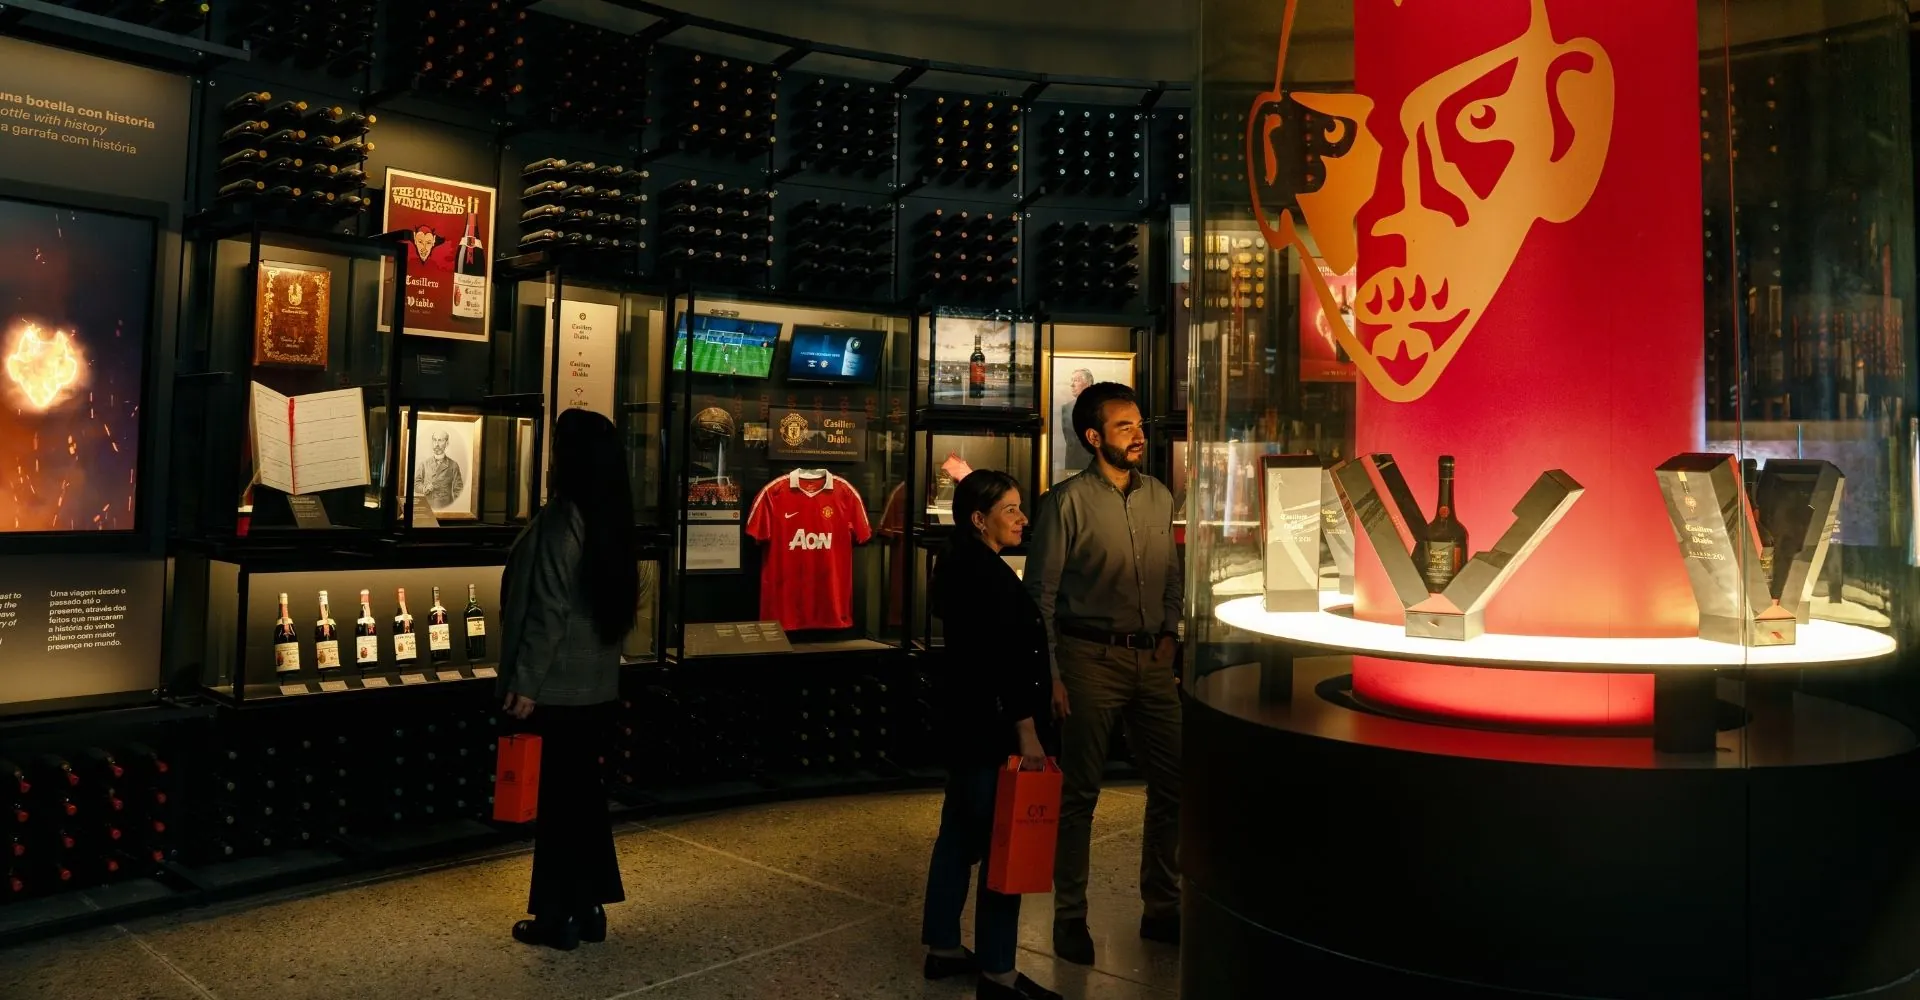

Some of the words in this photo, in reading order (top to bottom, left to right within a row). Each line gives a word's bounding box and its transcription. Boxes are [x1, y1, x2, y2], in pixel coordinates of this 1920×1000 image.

[26, 94, 75, 114] botella
[78, 106, 103, 119] con
[106, 110, 155, 129] historia
[0, 108, 31, 120] ottle
[34, 113, 61, 127] with
[64, 117, 108, 135] history
[12, 125, 58, 141] garrafa
[61, 134, 89, 146] com
[93, 137, 137, 154] história
[392, 186, 415, 197] THE
[415, 187, 466, 207] ORIGINAL
[392, 195, 421, 210] WINE
[422, 199, 465, 215] LEGEND
[405, 274, 439, 288] Casillero
[407, 296, 434, 308] Diablo
[823, 418, 856, 429] Casillero
[827, 434, 852, 444] Diablo
[788, 528, 833, 551] AON
[70, 590, 97, 598] viagem
[49, 598, 81, 607] passado
[49, 608, 84, 616] presente,
[85, 605, 112, 613] através
[8, 619, 17, 627] of
[48, 616, 70, 624] feitos
[95, 622, 115, 630] vinho
[47, 643, 82, 651] presença
[95, 639, 122, 647] mundo.
